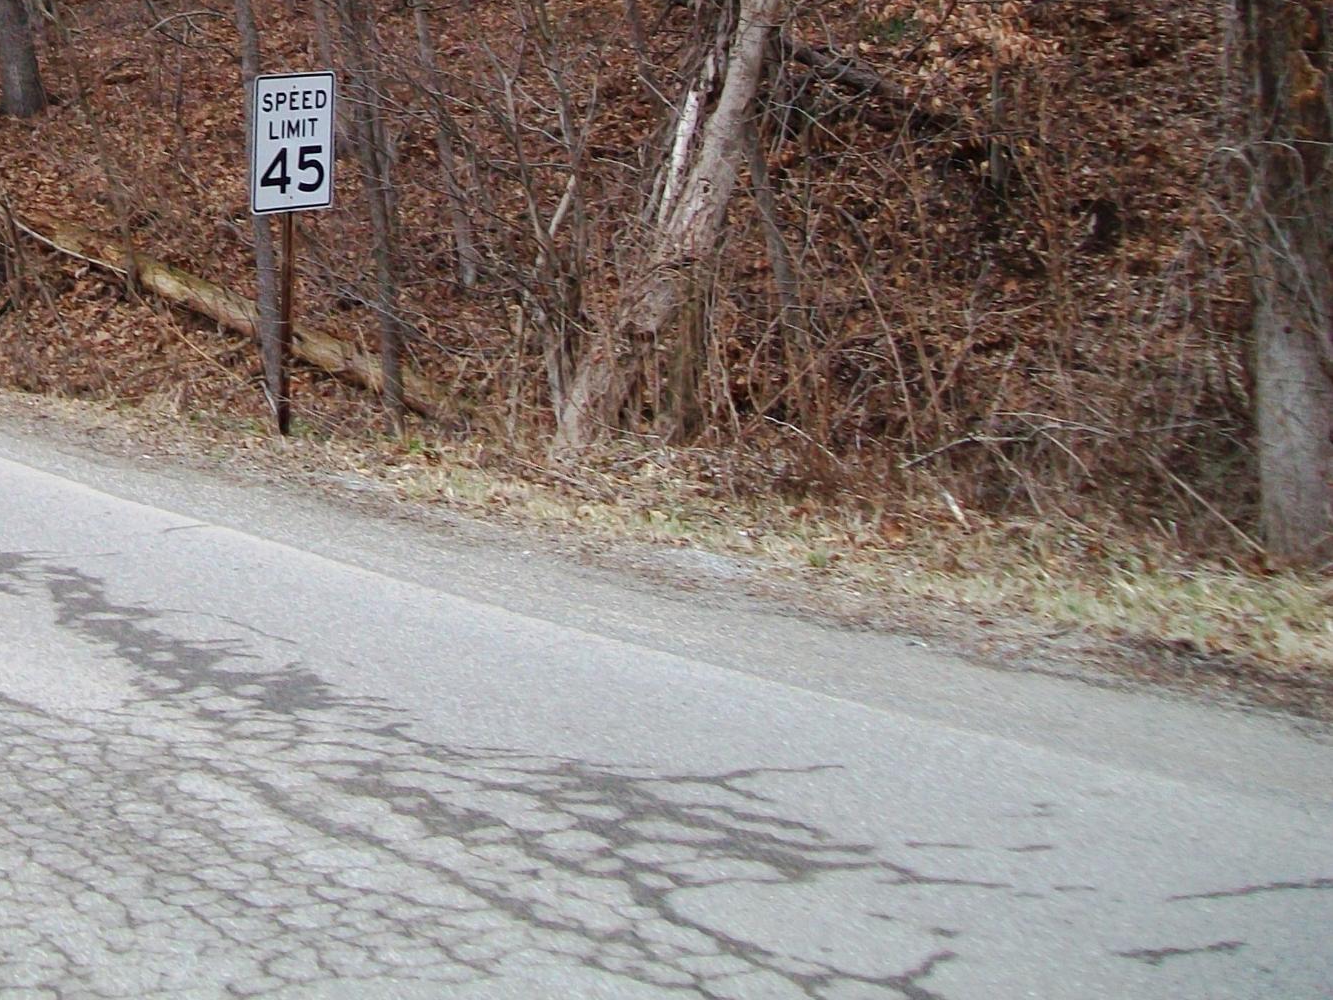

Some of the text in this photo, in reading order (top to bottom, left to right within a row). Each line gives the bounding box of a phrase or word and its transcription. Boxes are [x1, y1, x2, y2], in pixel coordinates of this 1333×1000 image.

[262, 90, 327, 112] SPEED
[269, 118, 318, 140] LIMIT
[260, 145, 324, 194] 45
